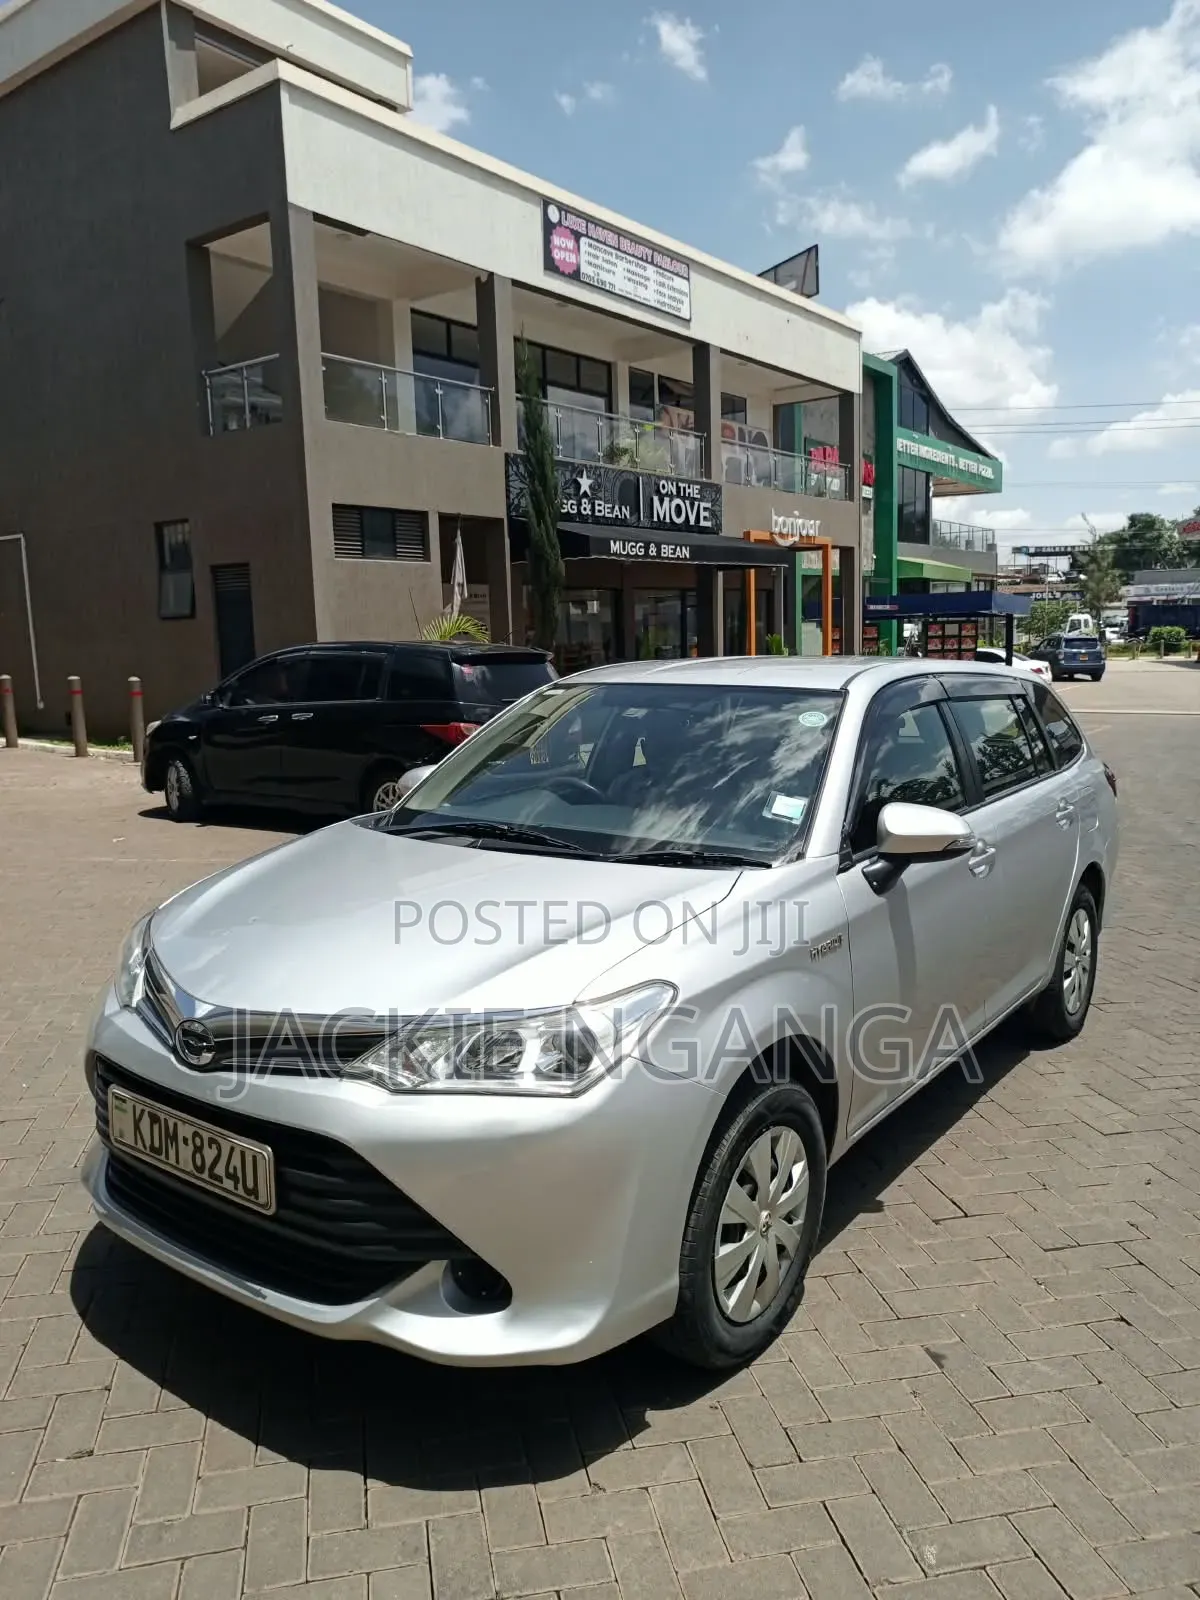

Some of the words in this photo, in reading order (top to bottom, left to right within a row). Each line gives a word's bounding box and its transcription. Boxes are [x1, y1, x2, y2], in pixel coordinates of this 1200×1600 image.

[553, 235, 574, 250] NOW
[619, 235, 653, 263] BEAUTY
[553, 249, 577, 264] OPEN
[659, 480, 677, 495] ON
[679, 482, 701, 498] THE
[580, 499, 592, 515] &
[594, 501, 630, 519] BEAN
[653, 495, 712, 528] MOVE
[771, 507, 821, 545] bonjour
[610, 539, 645, 556] MUGG
[649, 543, 657, 556] &
[661, 544, 690, 559] BEAN
[132, 1104, 180, 1165] KDM
[191, 1131, 260, 1200] 824U
